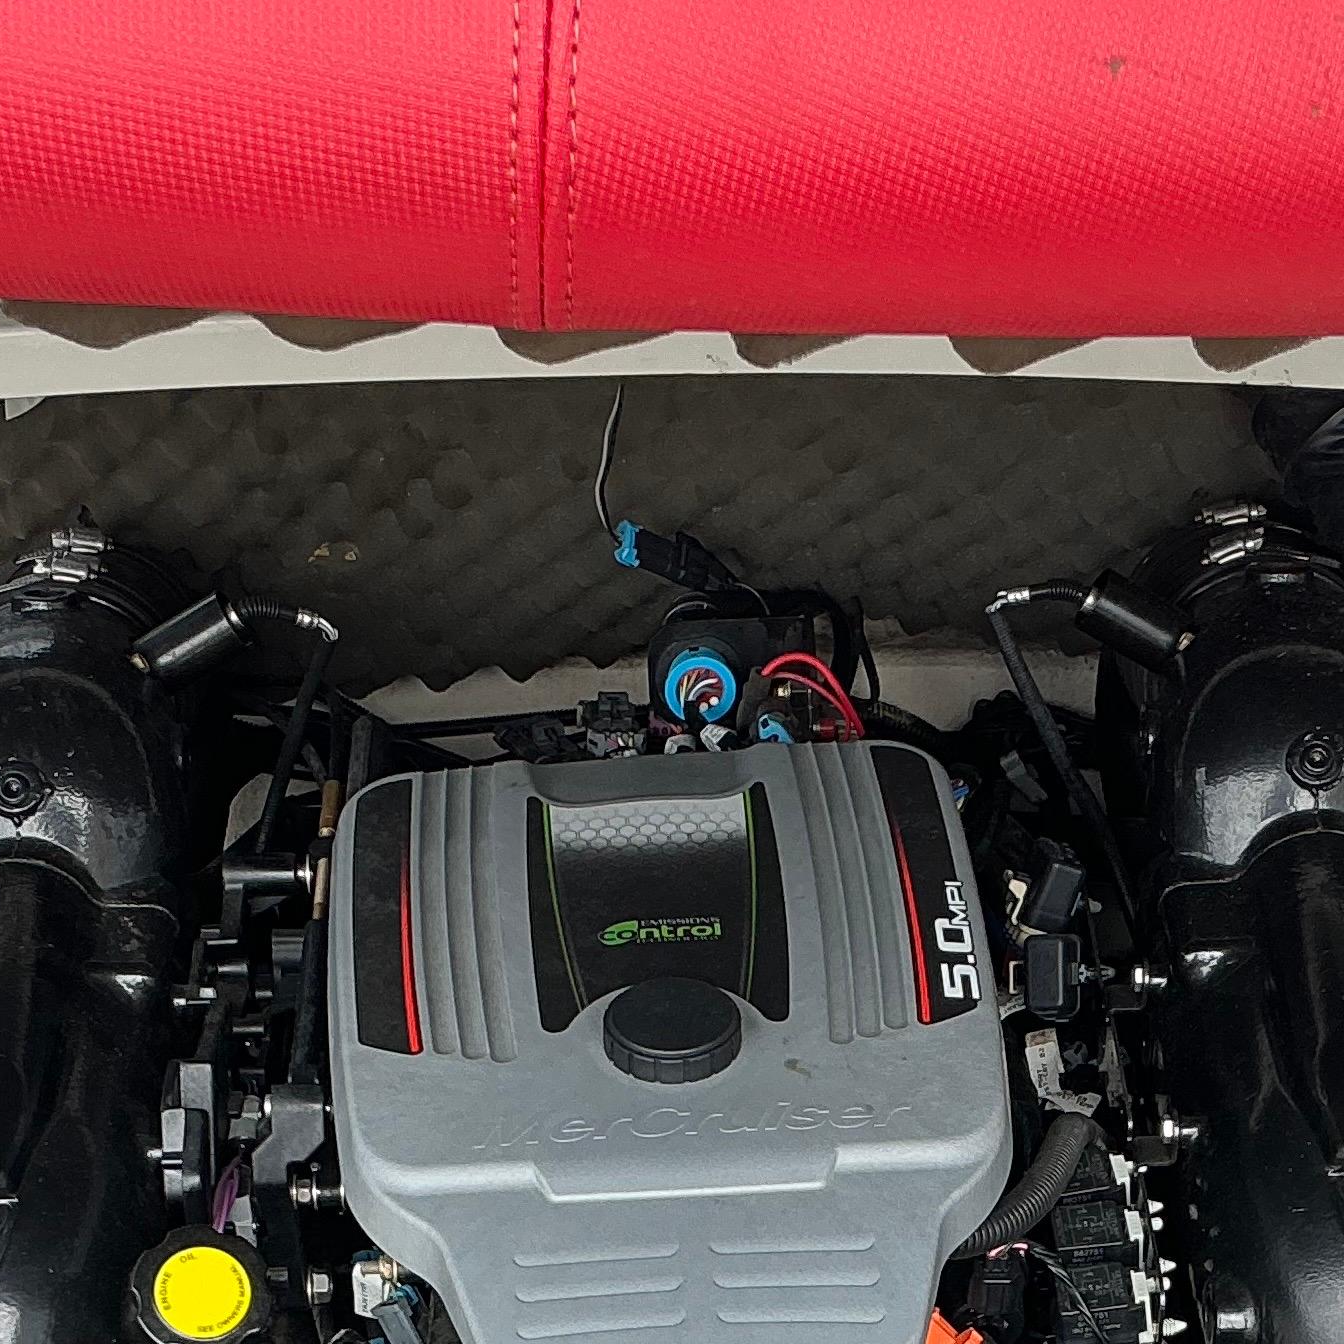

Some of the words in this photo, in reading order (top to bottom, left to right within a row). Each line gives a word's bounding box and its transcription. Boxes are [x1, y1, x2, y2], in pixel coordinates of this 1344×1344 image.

[934, 880, 981, 1000] 5.0MPI
[471, 1100, 912, 1150] MerCruiser
[179, 1252, 197, 1264] OIL
[159, 1271, 172, 1311] ENGINE
[197, 1325, 215, 1333] SEE
